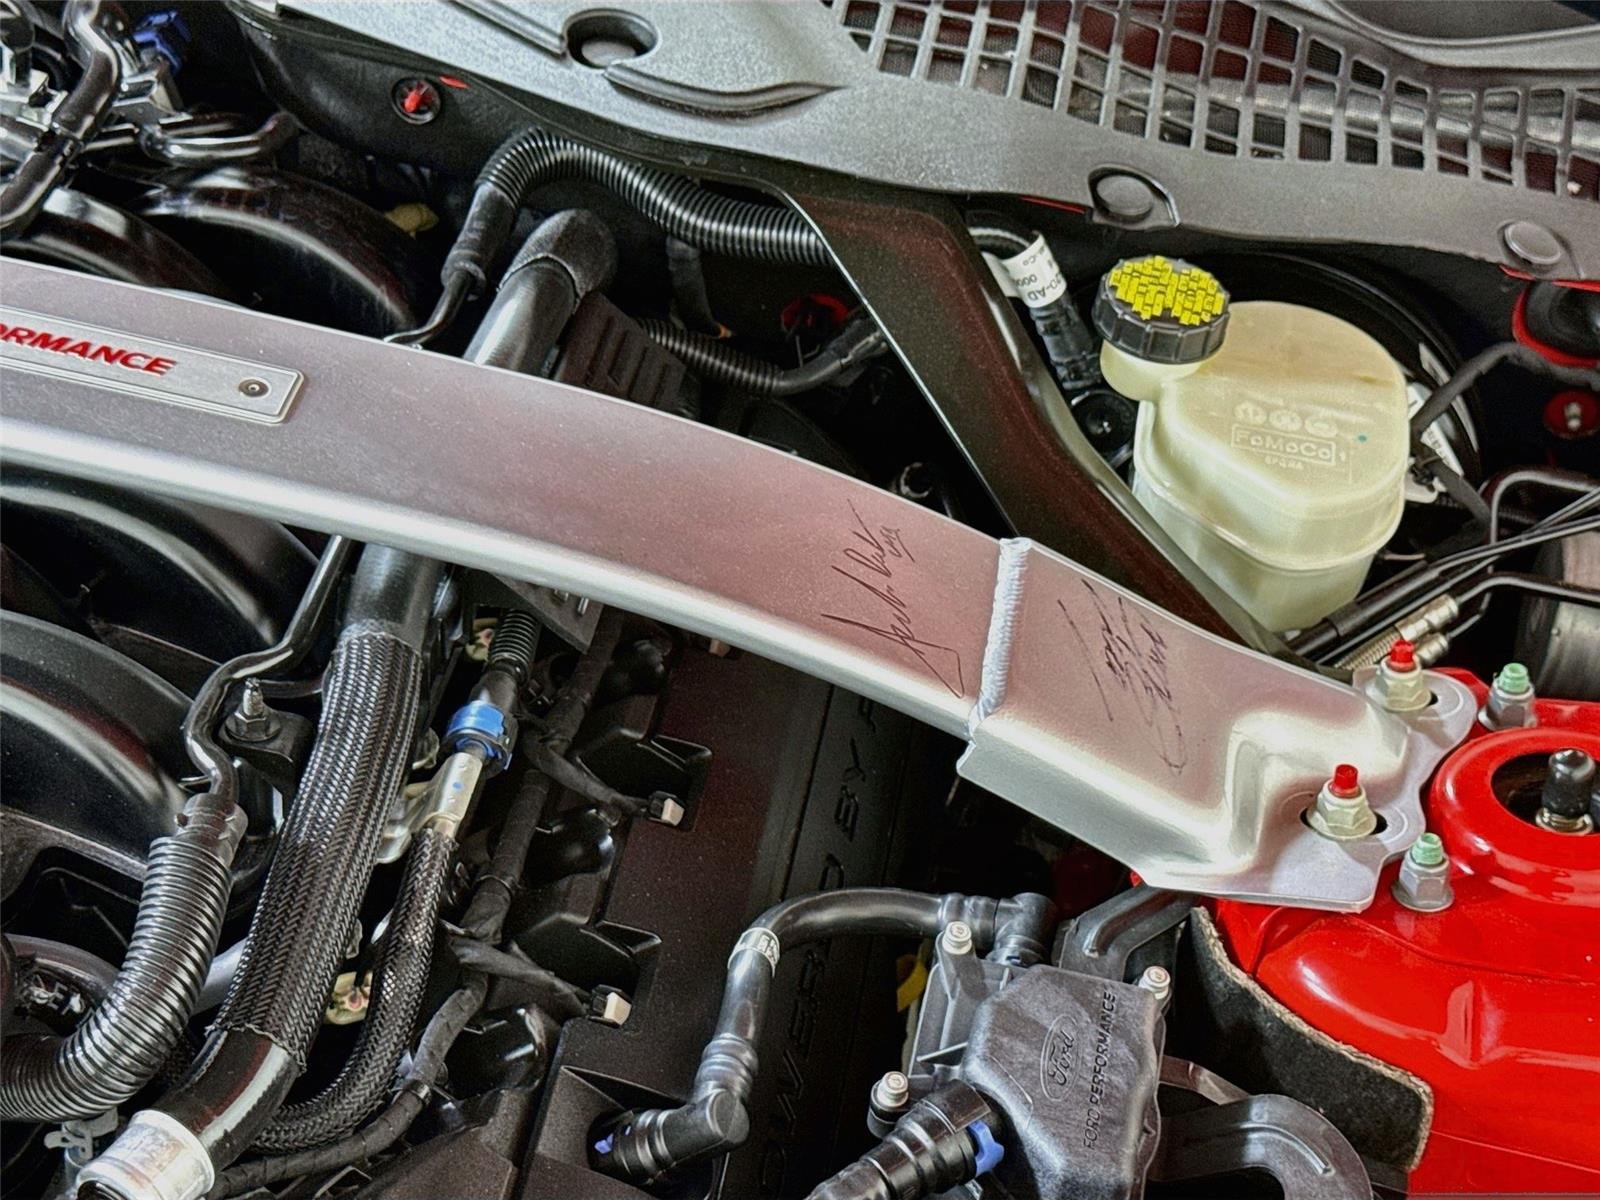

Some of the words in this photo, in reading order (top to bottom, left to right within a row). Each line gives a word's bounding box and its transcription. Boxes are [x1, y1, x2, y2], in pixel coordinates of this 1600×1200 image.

[1235, 429, 1332, 460] FoMoCo
[1048, 1029, 1075, 1087] Ford
[1090, 990, 1117, 1106] PERFORMANCE
[1083, 1107, 1102, 1150] FORD
